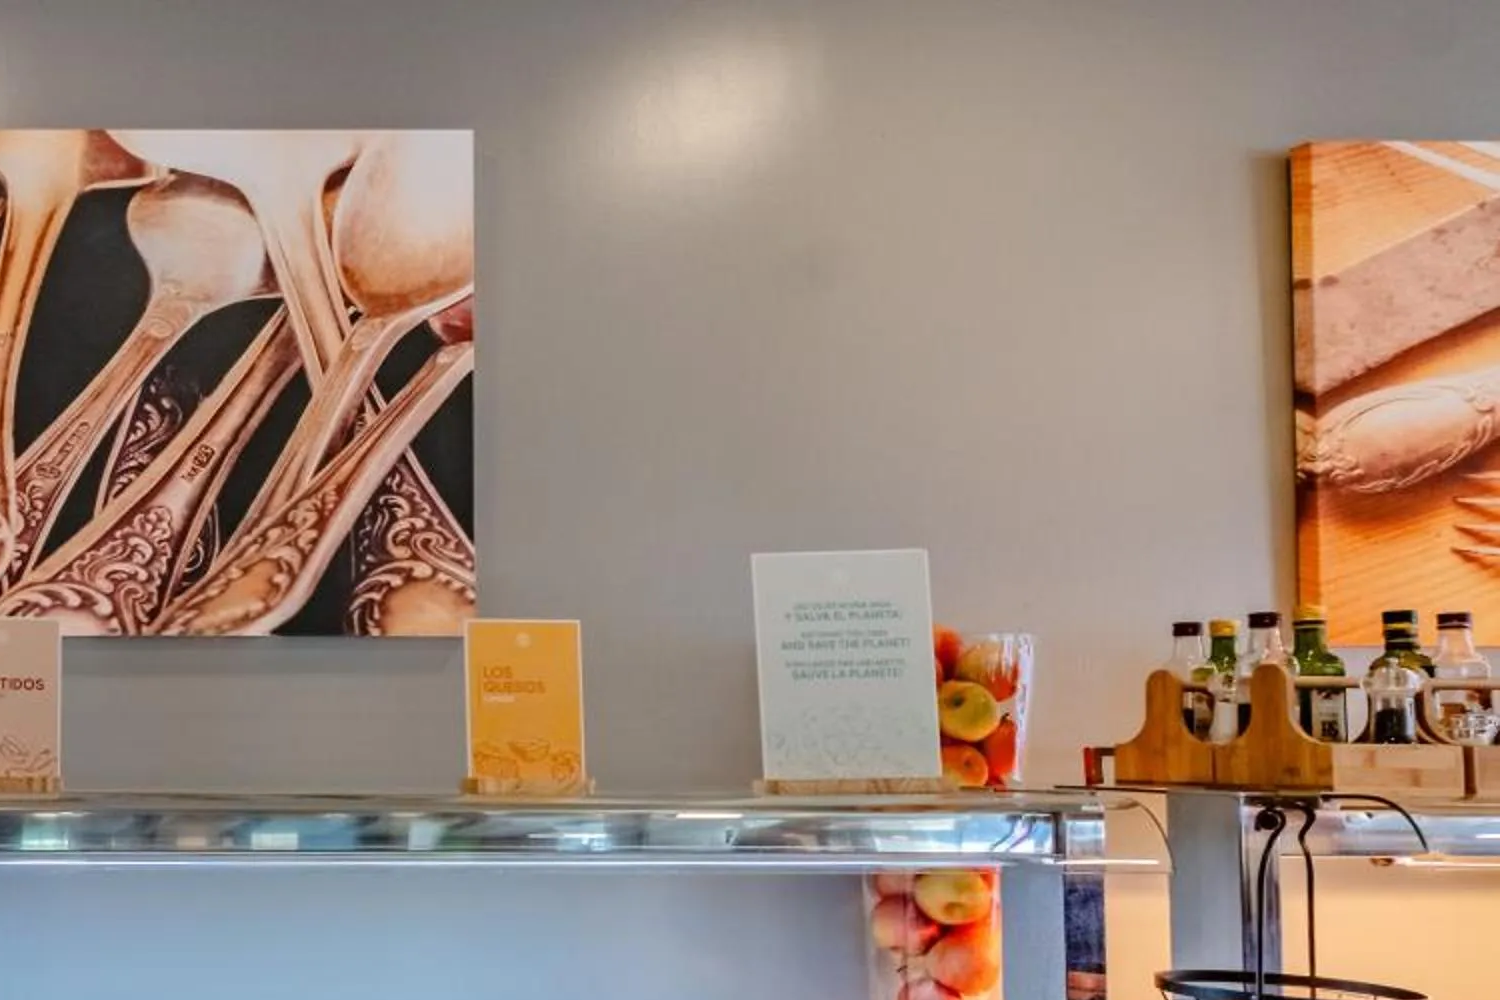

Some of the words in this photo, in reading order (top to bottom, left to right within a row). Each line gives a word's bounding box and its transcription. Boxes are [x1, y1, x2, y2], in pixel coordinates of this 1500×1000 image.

[795, 610, 831, 623] SALVA
[483, 665, 513, 679] LOS
[483, 680, 546, 694] QUESOS
